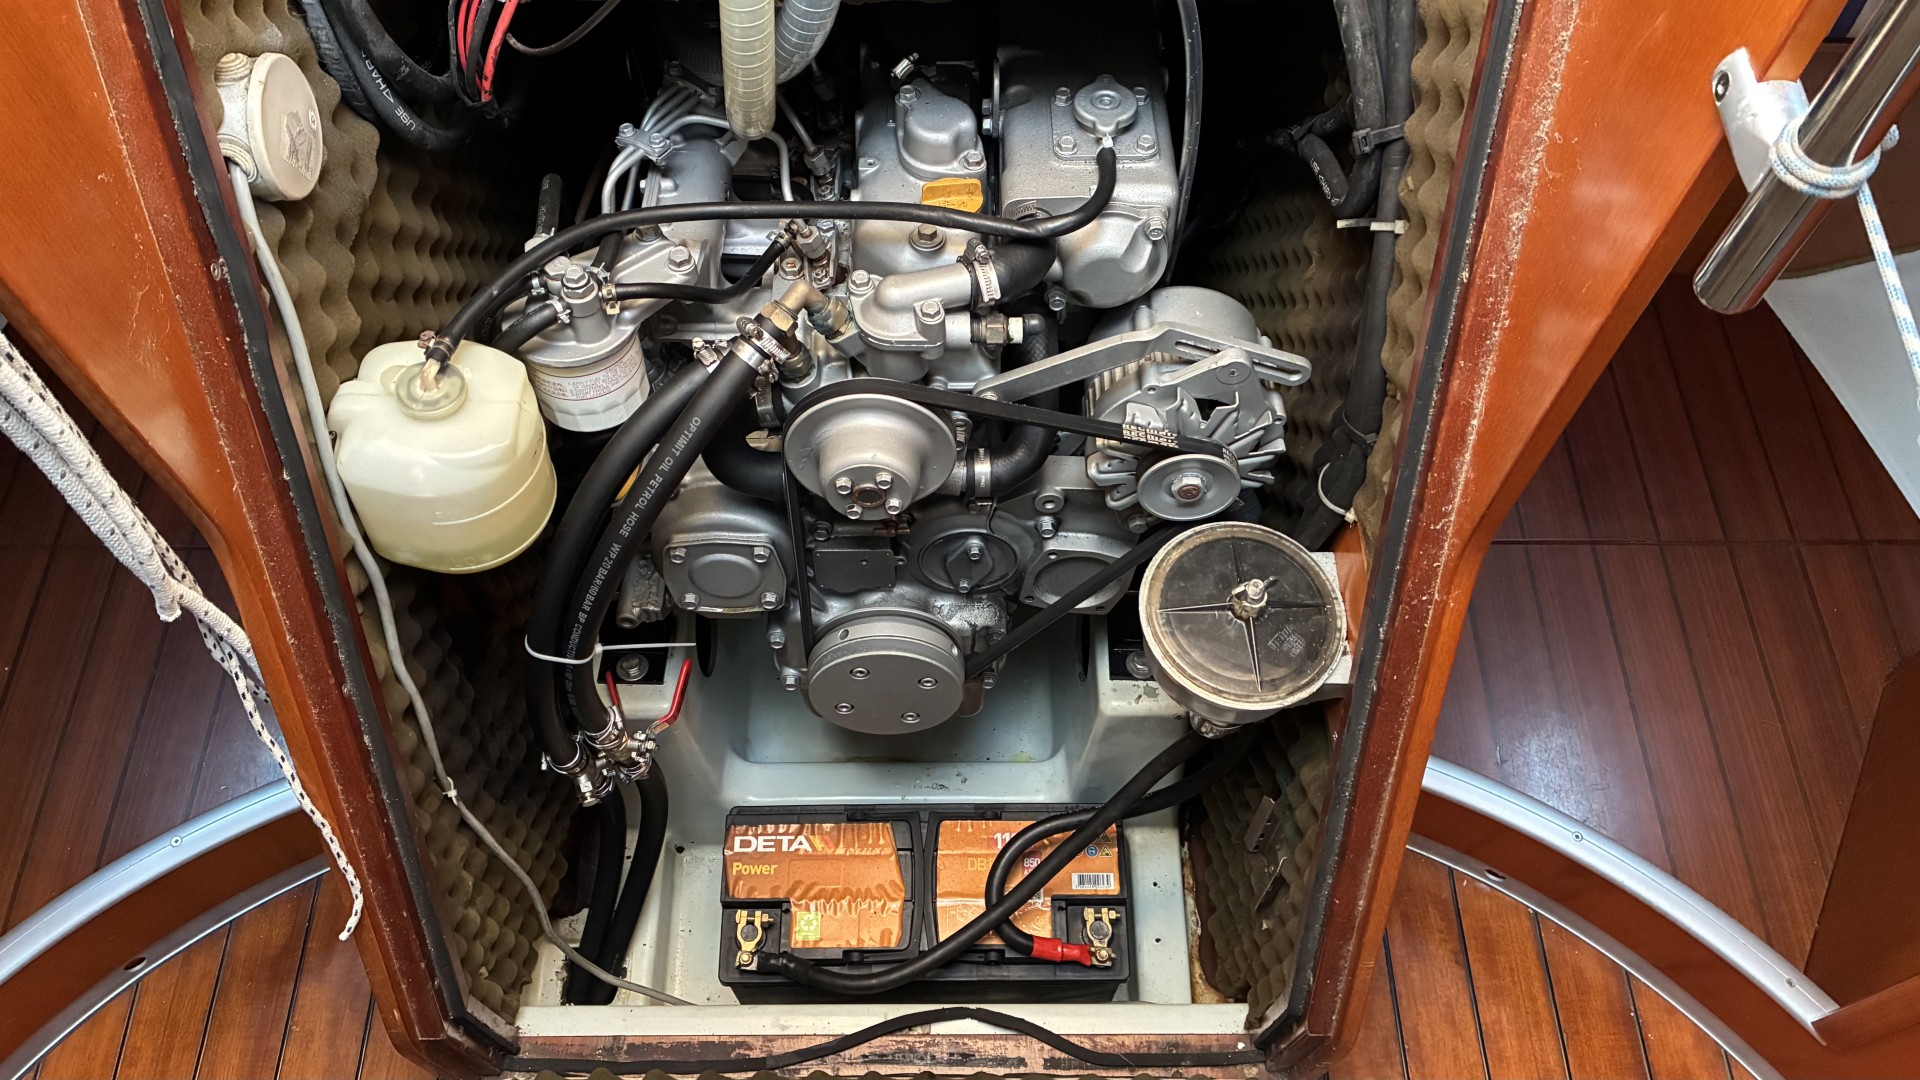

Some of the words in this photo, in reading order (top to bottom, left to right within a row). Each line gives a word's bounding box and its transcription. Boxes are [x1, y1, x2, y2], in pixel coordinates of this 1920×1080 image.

[395, 106, 416, 131] USE
[671, 416, 701, 457] OPTIMIT
[659, 456, 674, 472] OIL
[634, 473, 664, 510] PETROL
[619, 511, 640, 538] HOSE
[608, 542, 622, 559] WP
[733, 834, 813, 853] DETA
[732, 861, 778, 875] Power
[1023, 857, 1041, 868] 850
